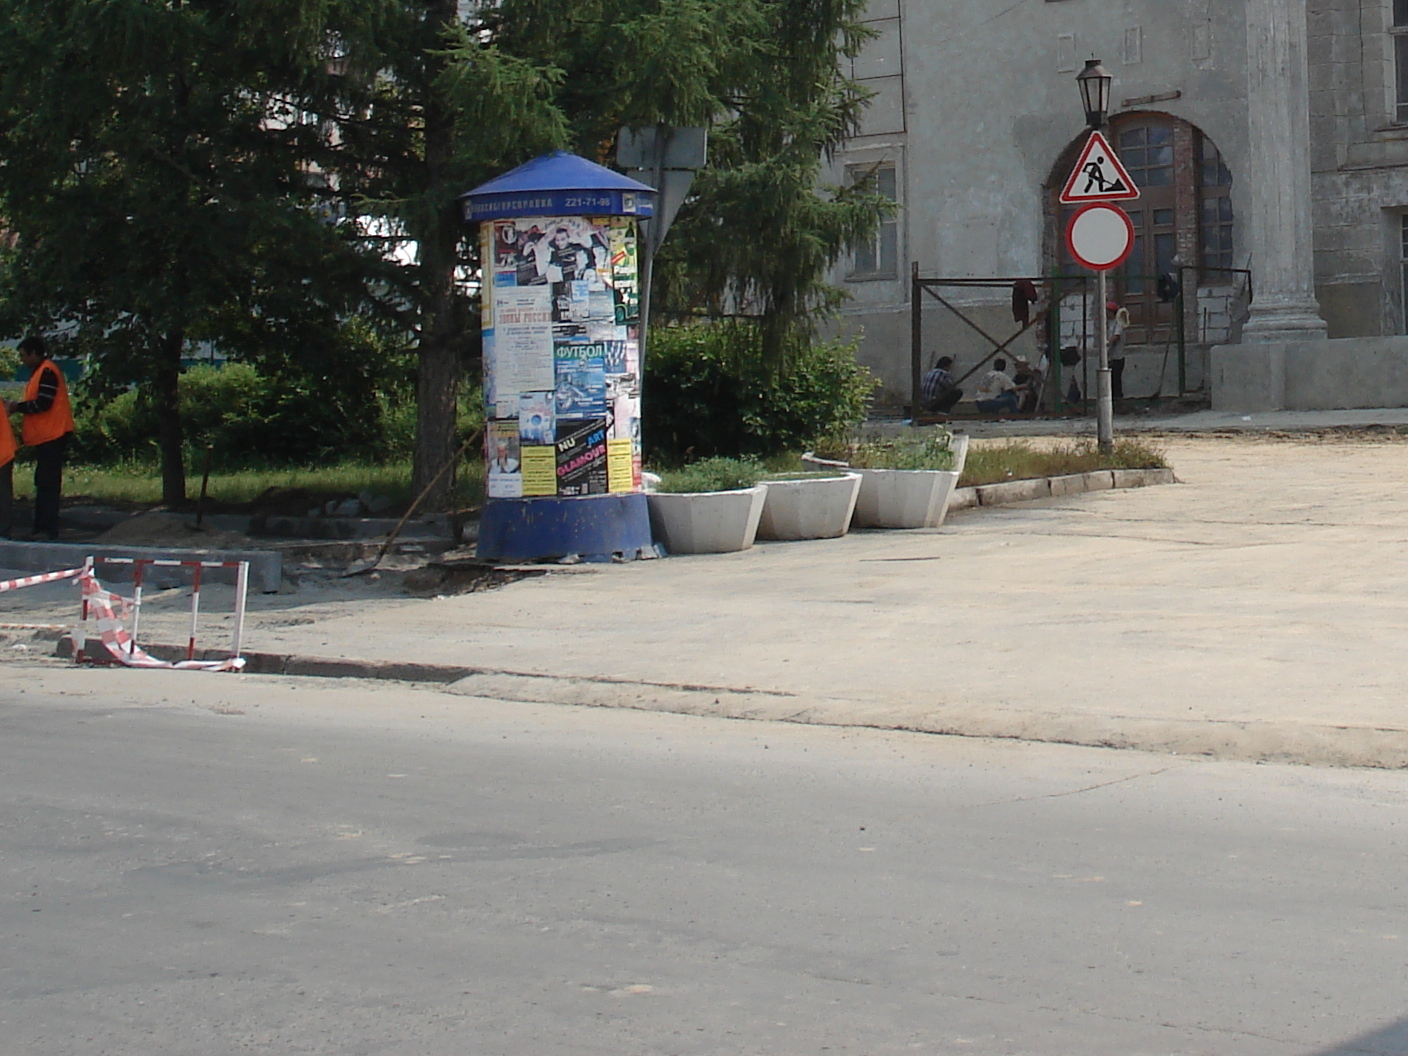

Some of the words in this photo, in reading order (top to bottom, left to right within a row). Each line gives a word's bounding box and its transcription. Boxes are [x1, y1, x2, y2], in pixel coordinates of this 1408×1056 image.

[556, 344, 603, 358] ФУТБОЛ
[558, 437, 576, 452] NU
[588, 429, 605, 447] ART
[556, 444, 606, 476] GLAMOUR
